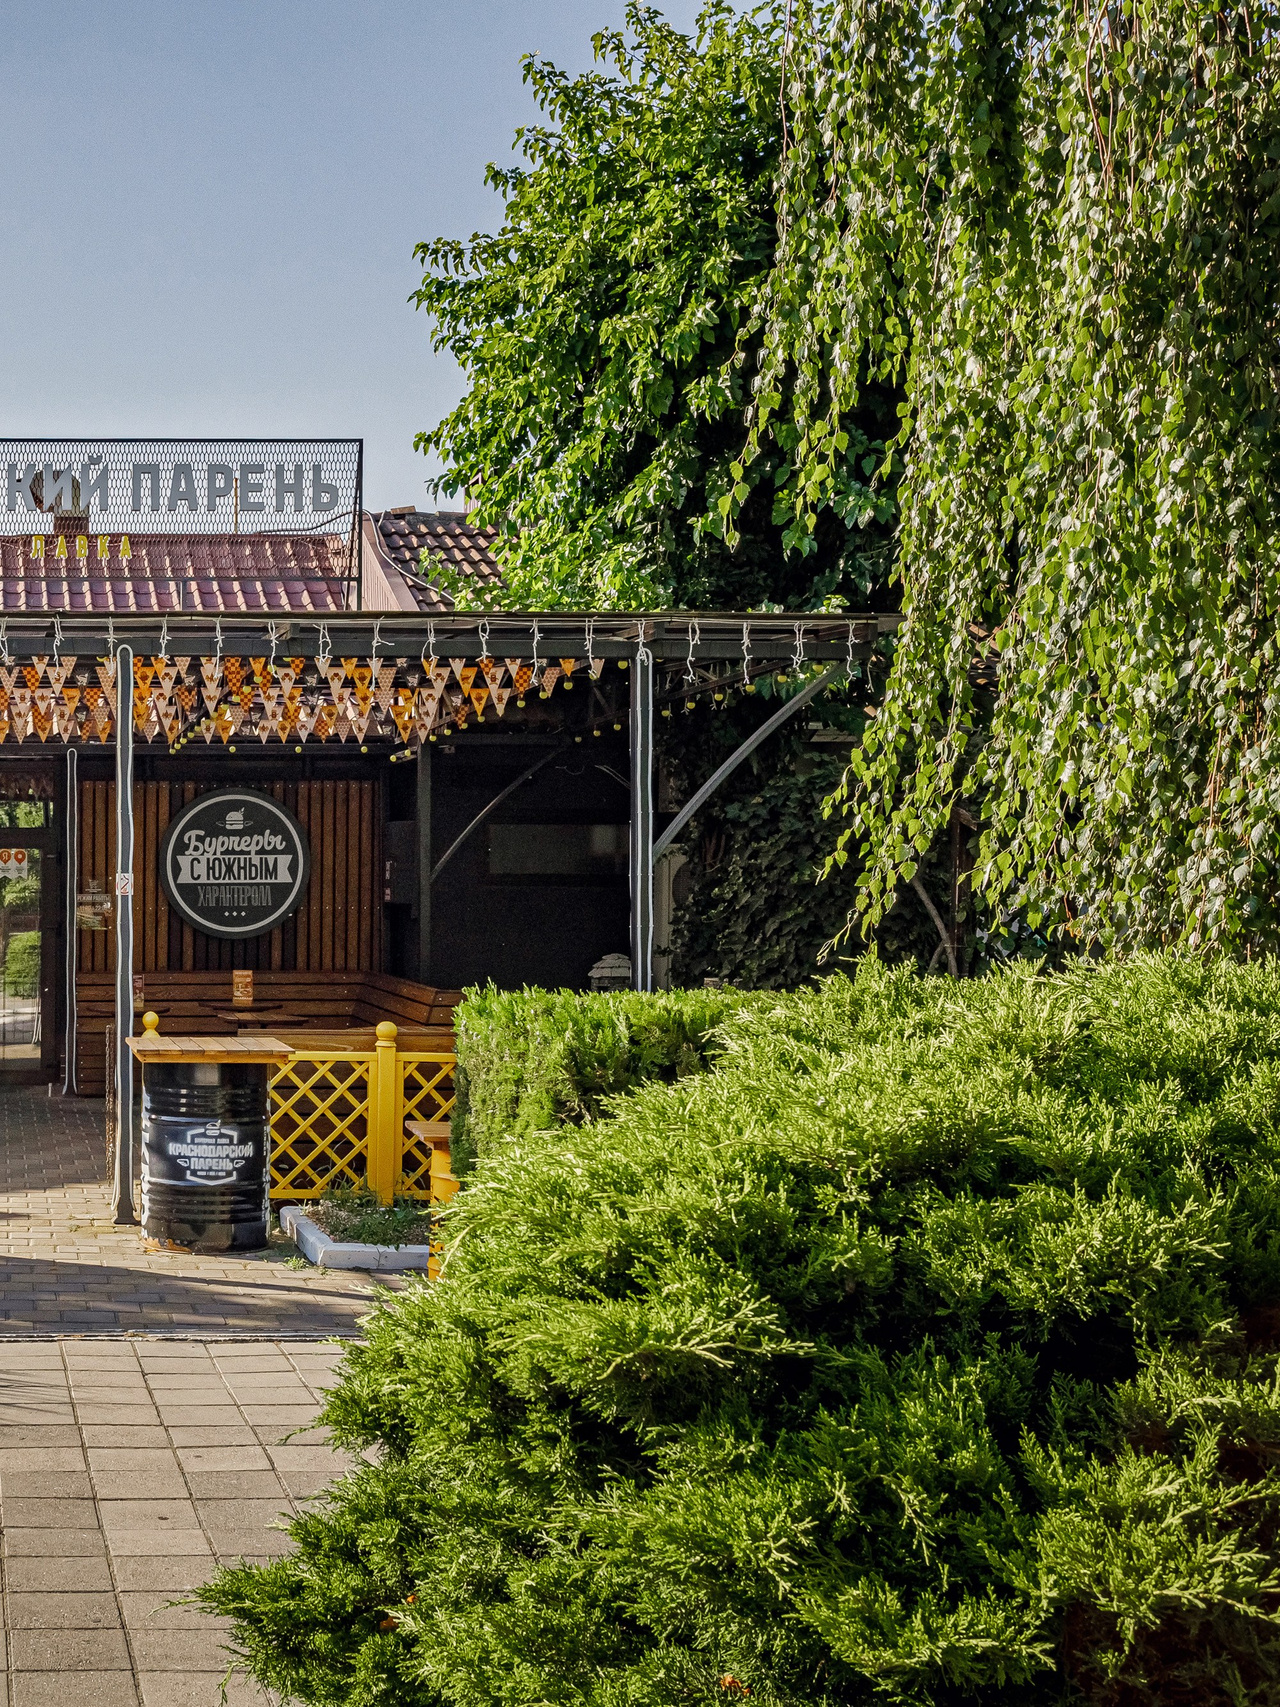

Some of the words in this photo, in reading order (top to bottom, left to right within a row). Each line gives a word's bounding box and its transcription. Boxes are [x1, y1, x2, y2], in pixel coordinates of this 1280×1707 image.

[132, 463, 339, 512] ПАРЕНЬ
[31, 535, 133, 560] ЛАВКА
[183, 829, 286, 857] Бургеры
[190, 857, 201, 881] С
[206, 857, 278, 881] ЮЖНЫМ
[197, 885, 272, 907] ХАРАКТЕРОМ
[168, 1142, 254, 1158] КРАСНОДАРСКИЙ
[190, 1157, 234, 1170] ПАРЕНЬ
